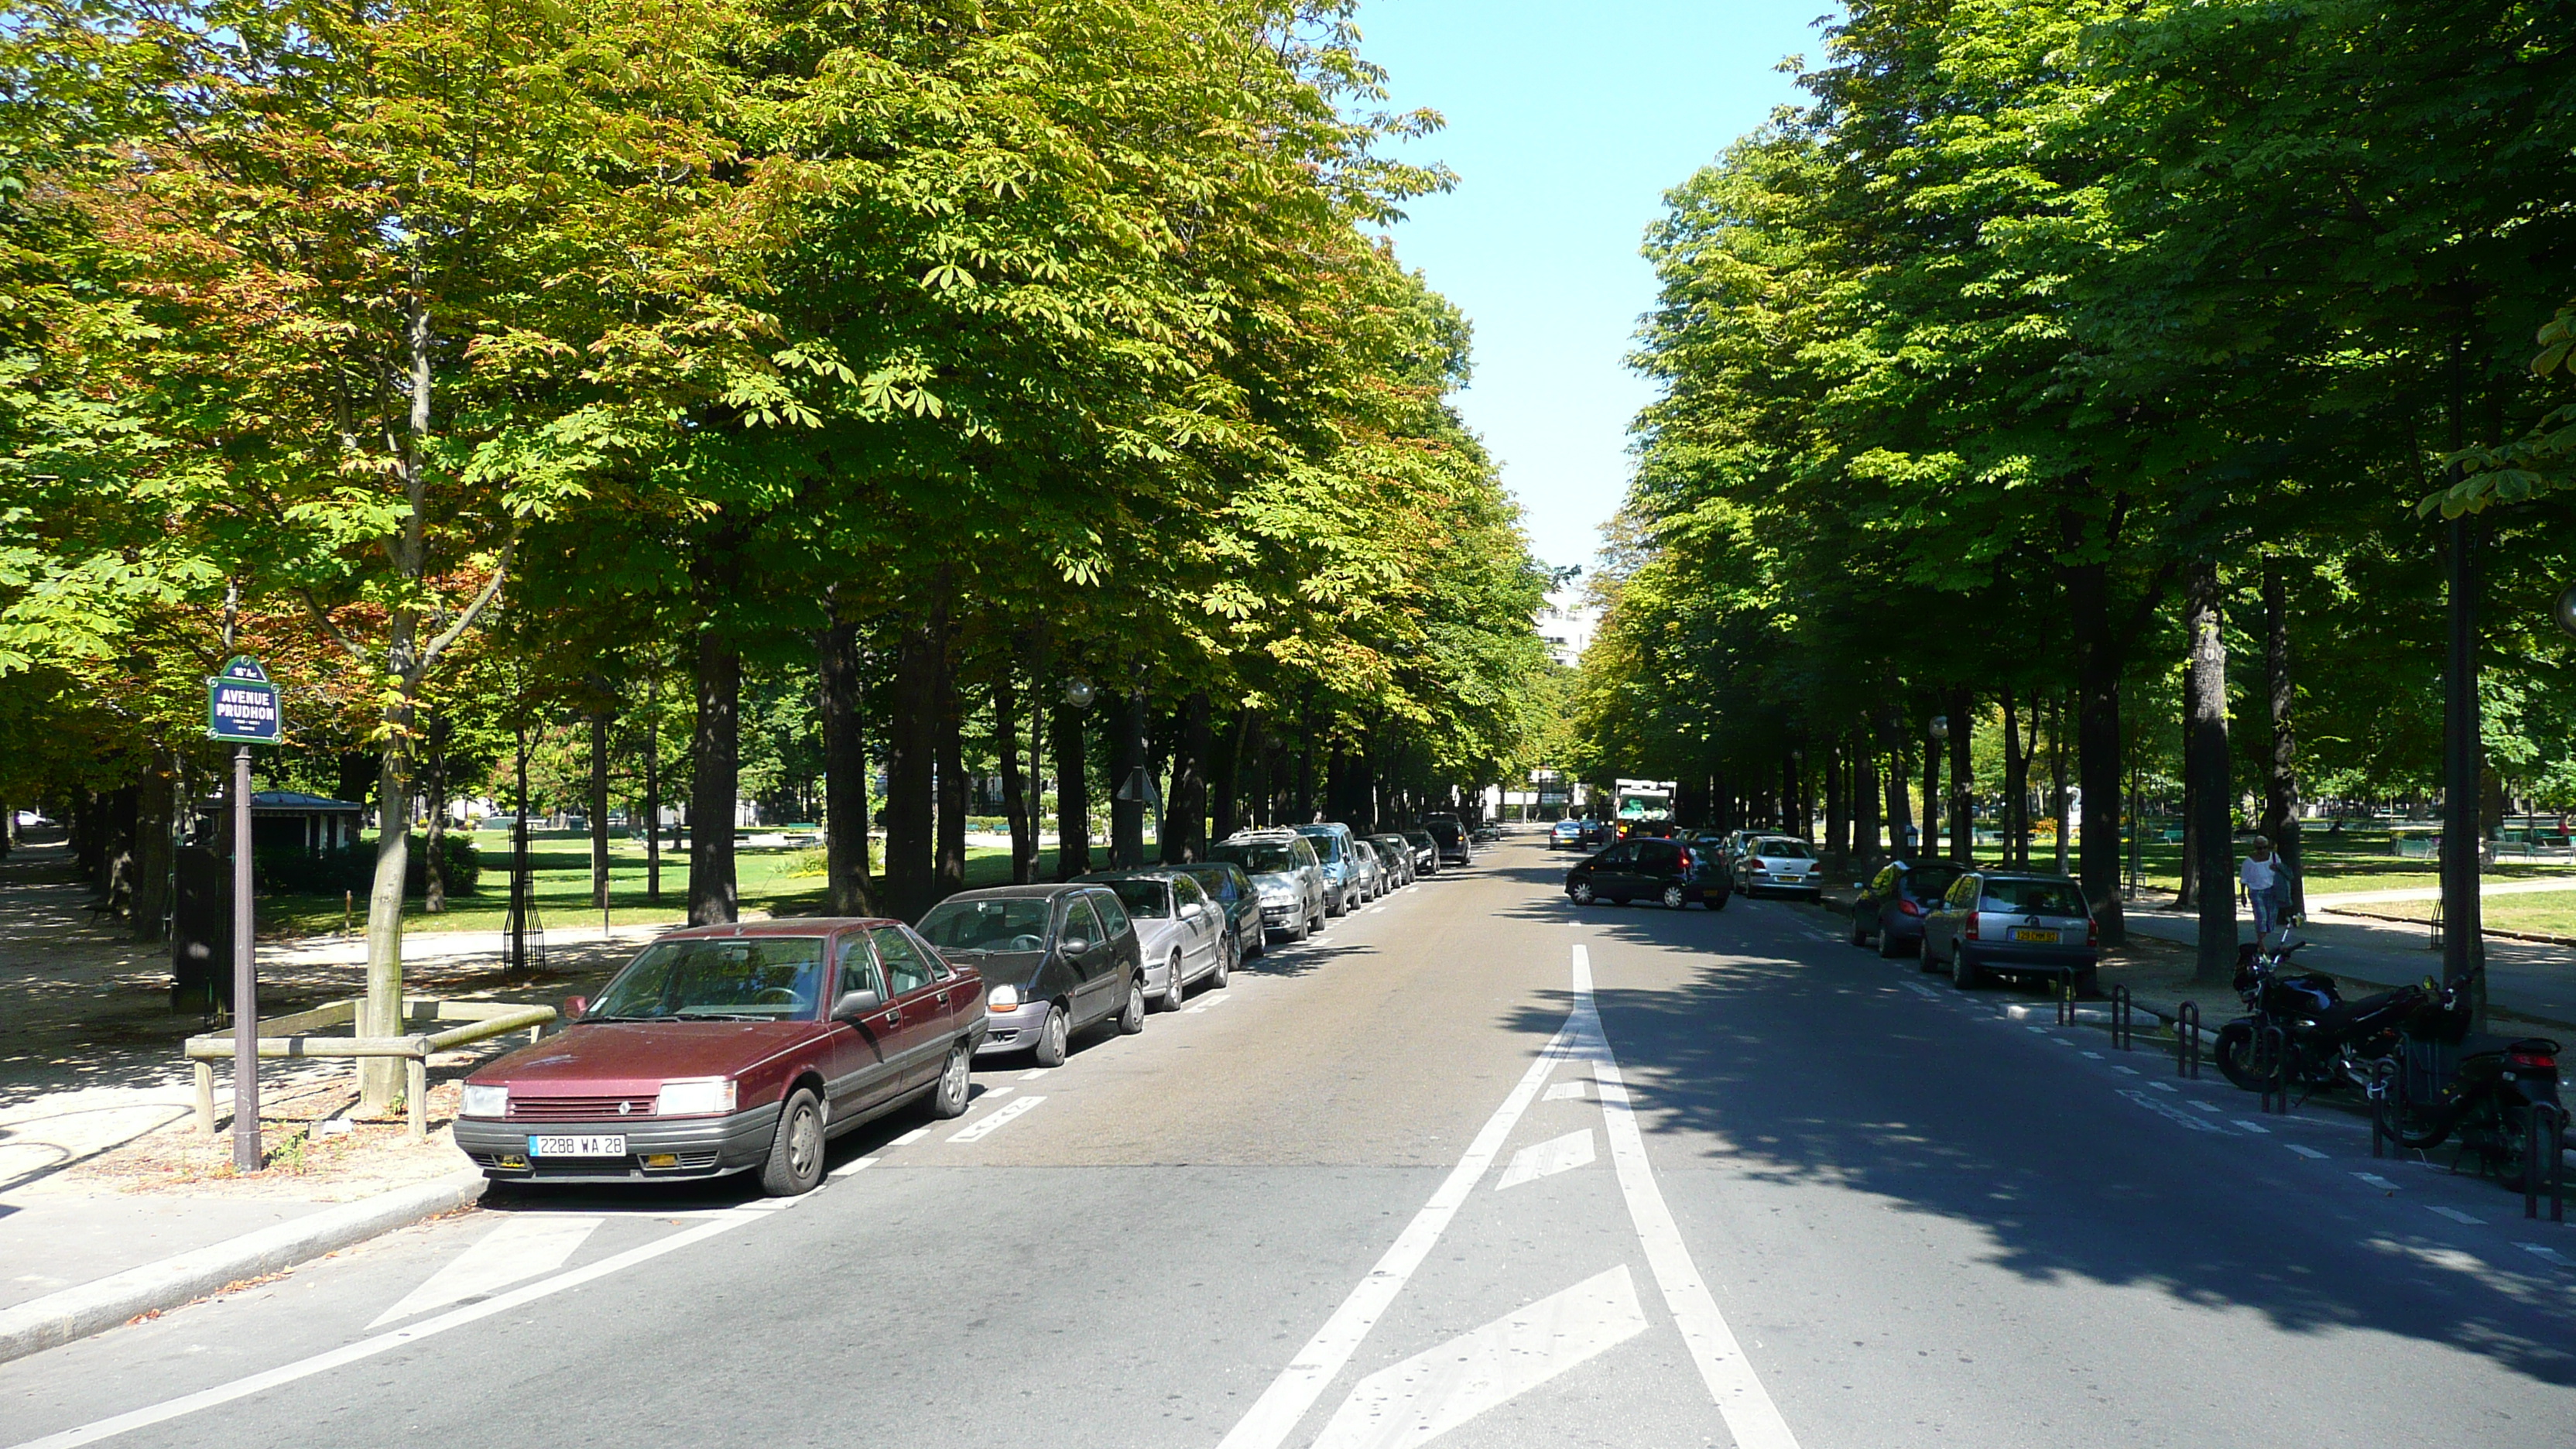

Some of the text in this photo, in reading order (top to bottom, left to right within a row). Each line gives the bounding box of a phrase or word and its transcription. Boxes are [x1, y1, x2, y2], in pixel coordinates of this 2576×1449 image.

[221, 689, 270, 706] AVENUE
[217, 703, 274, 721] PRUDHON
[540, 1138, 622, 1154] 2288 WA 28
